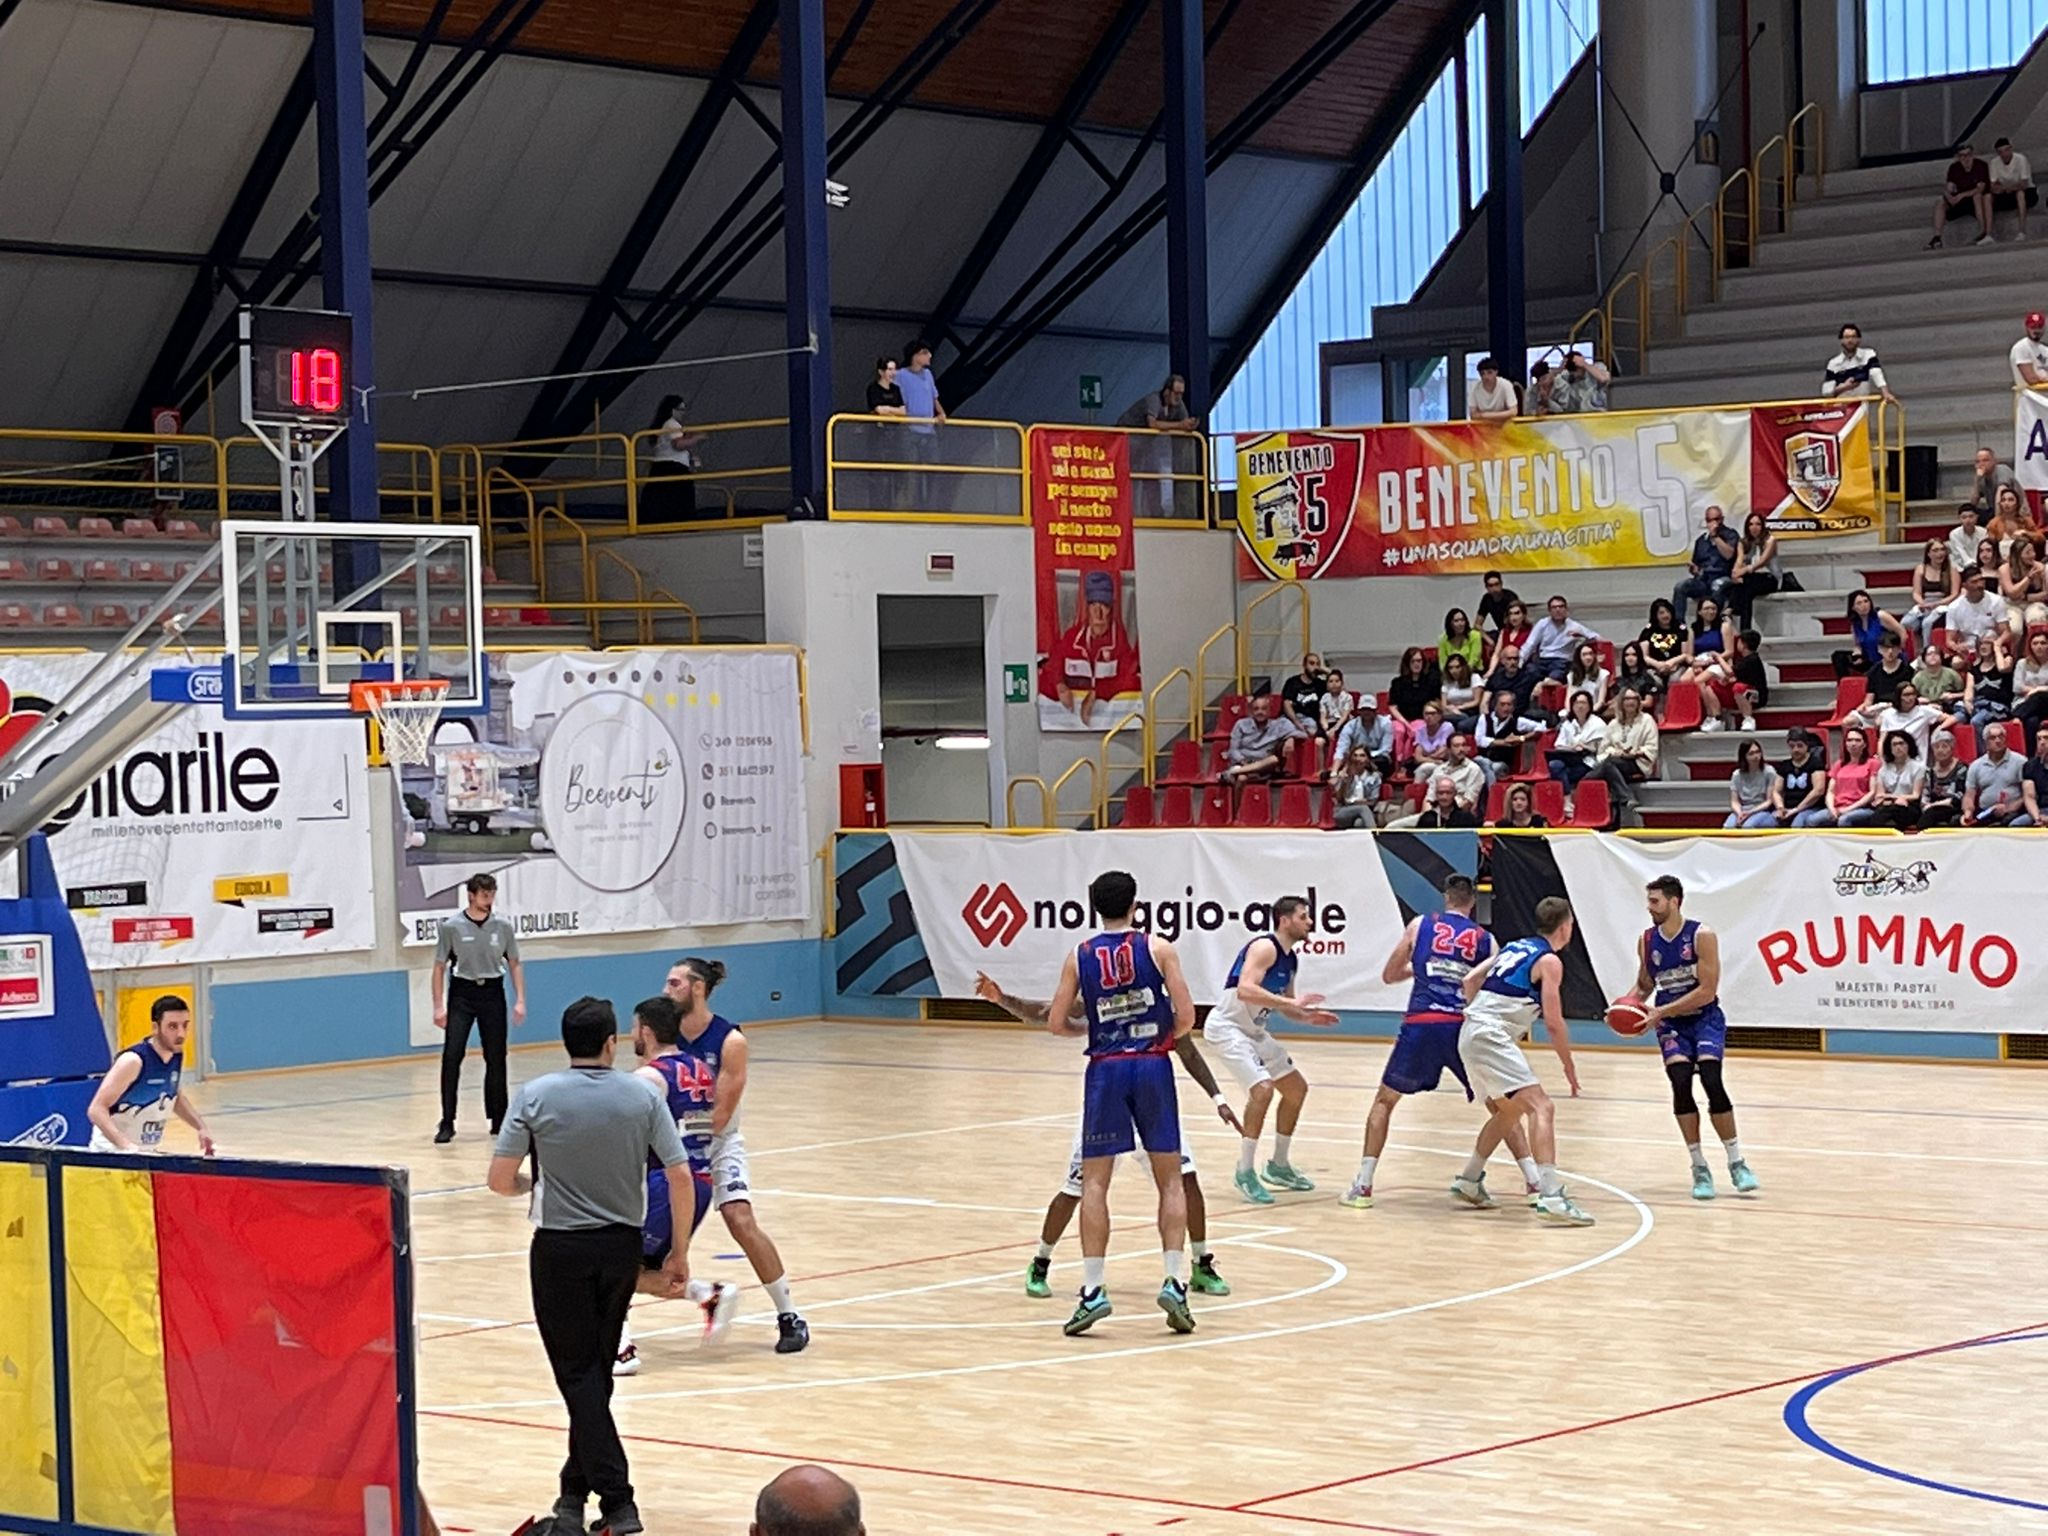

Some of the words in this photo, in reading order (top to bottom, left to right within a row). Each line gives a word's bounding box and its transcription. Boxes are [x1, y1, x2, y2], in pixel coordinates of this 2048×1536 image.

[292, 349, 341, 412] 18
[1248, 445, 1332, 476] BENEVENTO
[1306, 475, 1325, 533] 5
[1377, 446, 1617, 536] BENEVENTO
[1637, 422, 1690, 557] 5
[1094, 941, 1136, 991] 10
[1431, 922, 1478, 962] 24
[1757, 915, 2018, 988] RUMMO
[1833, 998, 1898, 1009] BENEVENTO
[1835, 981, 1888, 993] MAESTRI
[1893, 983, 1937, 993] PASTAI
